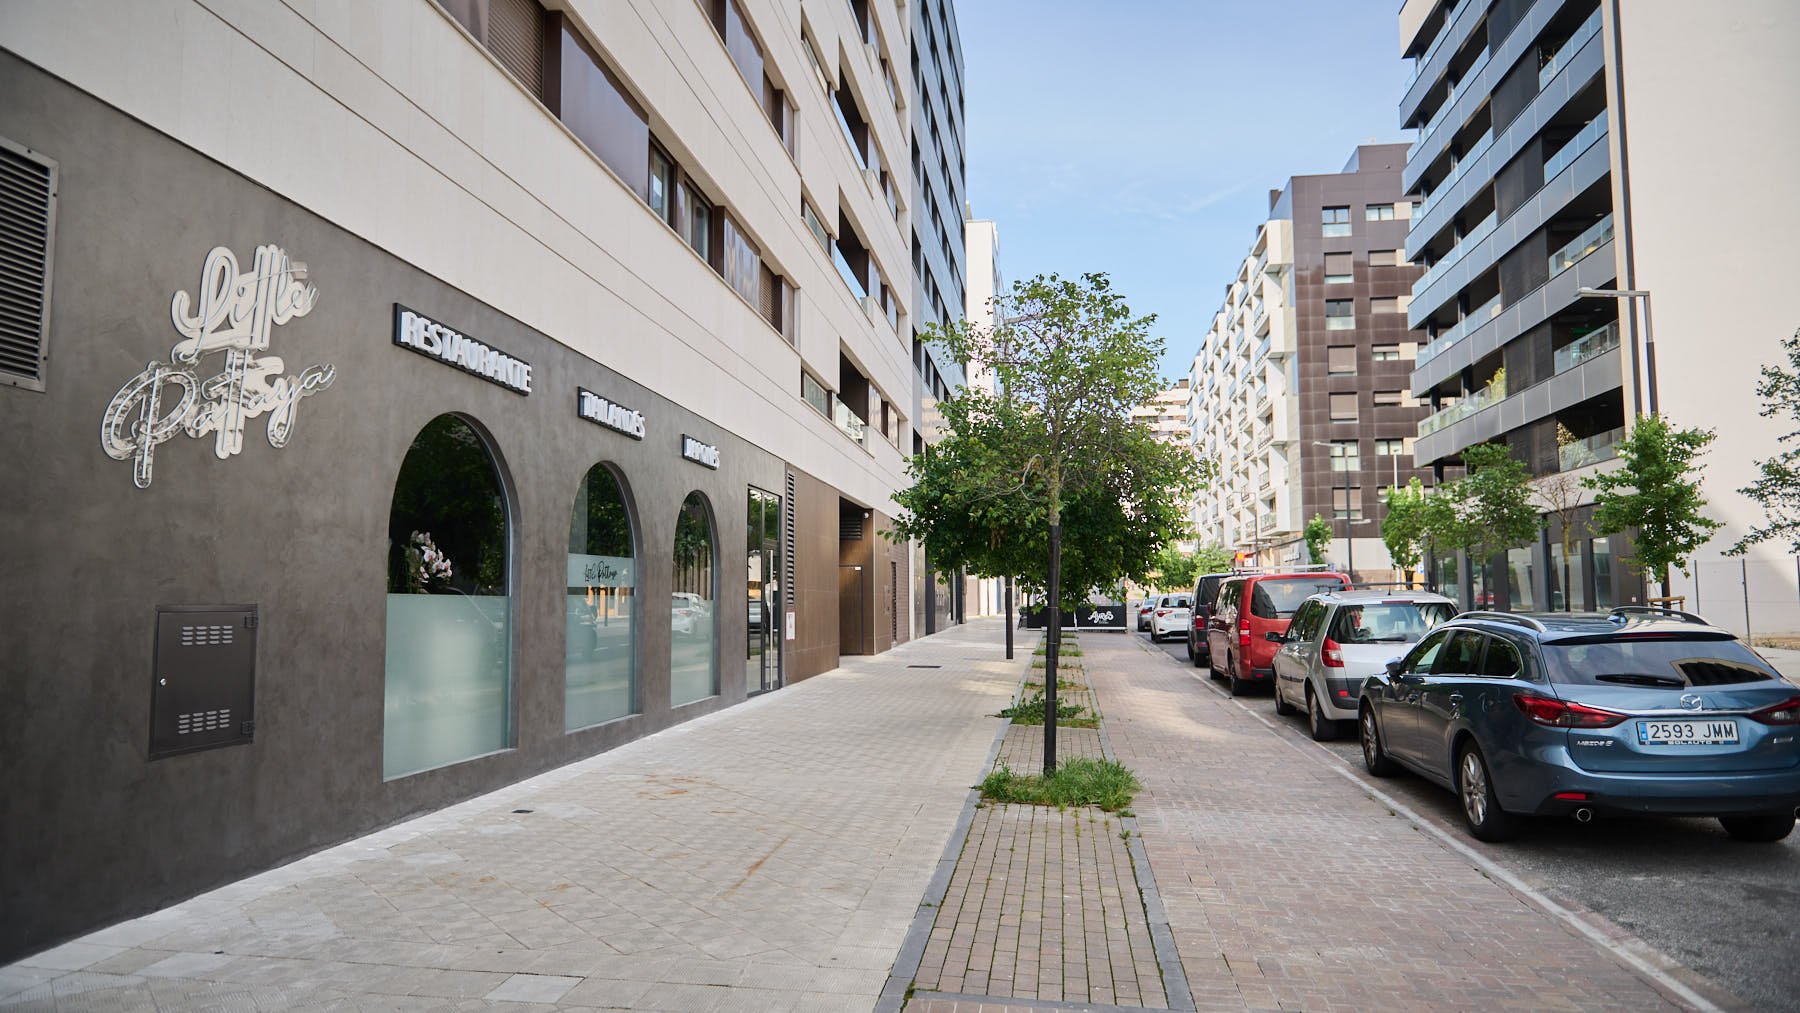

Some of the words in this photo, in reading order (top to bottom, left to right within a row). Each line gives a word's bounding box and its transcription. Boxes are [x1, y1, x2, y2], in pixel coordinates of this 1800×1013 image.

[171, 244, 320, 364] Little
[401, 311, 532, 393] RESTAURANTE
[1650, 724, 1695, 739] 2593
[1703, 723, 1735, 739] JMM
